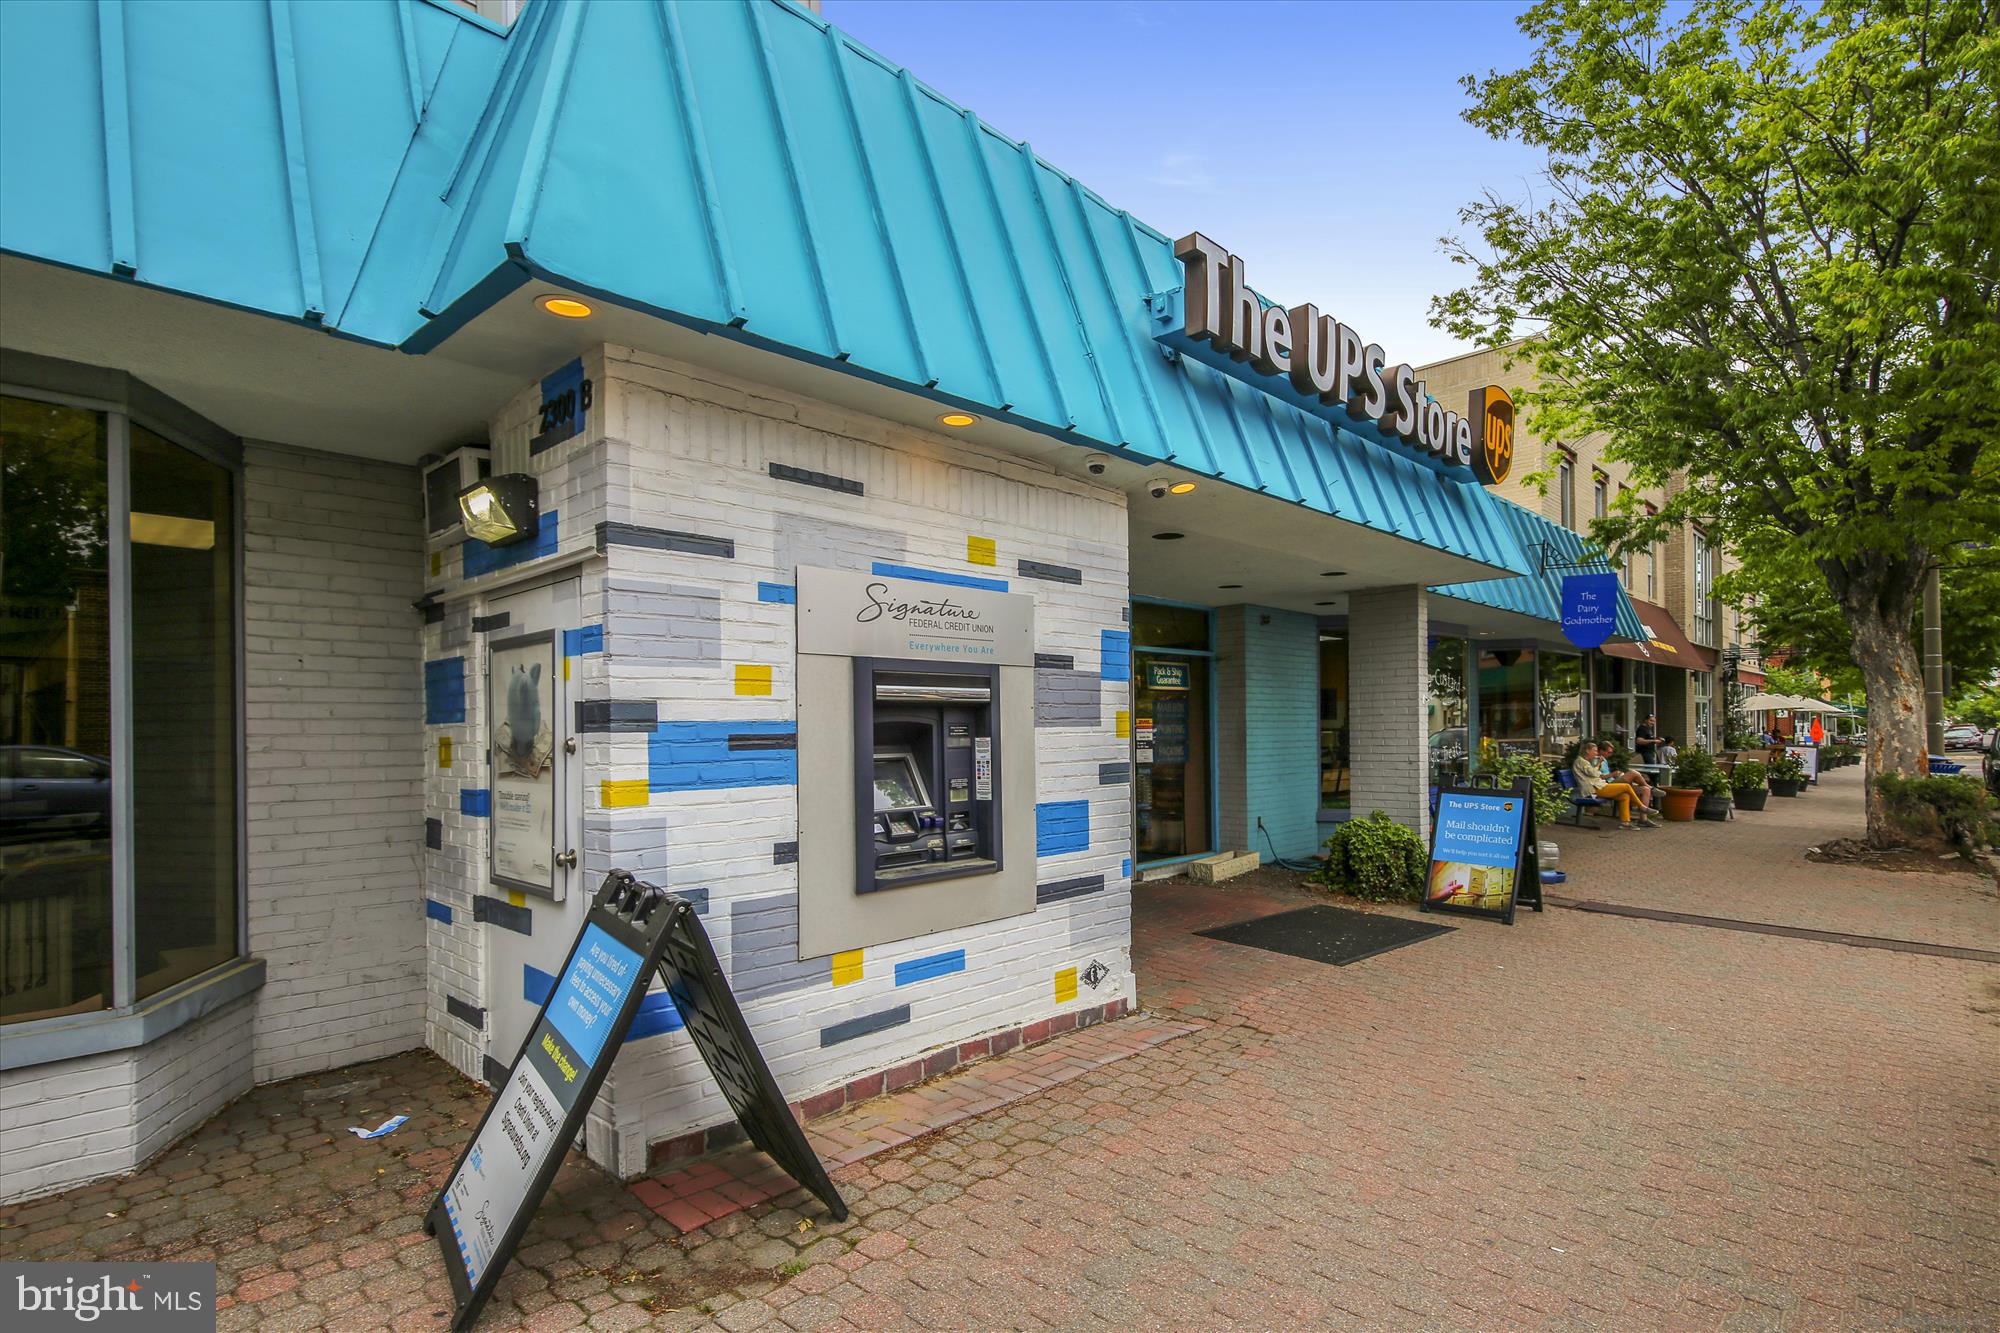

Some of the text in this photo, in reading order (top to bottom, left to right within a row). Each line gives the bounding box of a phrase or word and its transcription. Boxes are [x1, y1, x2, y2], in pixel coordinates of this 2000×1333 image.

[1190, 231, 1472, 466] The UPS Store
[539, 379, 593, 434] 2300 B
[1487, 412, 1512, 468] ups
[856, 583, 981, 622] Signature
[1577, 604, 1600, 613] Dairy
[1580, 592, 1597, 600] The
[909, 618, 994, 633] FEDERAL CREDIT UNION
[1564, 614, 1613, 625] Godmother
[909, 641, 994, 655] Everywhere You Are
[1153, 666, 1166, 675] Pack
[1171, 667, 1182, 677] Ship
[1156, 675, 1181, 685] Guarantee
[1449, 800, 1462, 808] The
[1463, 801, 1479, 810] UPS
[1480, 802, 1501, 811] Store
[1444, 831, 1513, 845] be complicated
[1446, 820, 1510, 833] Mail shouldn't
[1455, 848, 1467, 856] help
[590, 943, 628, 977] Are you tired of
[576, 957, 622, 1002] paying unnecessary
[570, 971, 612, 1017] fees to access your
[576, 1004, 597, 1029] money?
[541, 1033, 578, 1082] Make the change!
[518, 1071, 559, 1132] Join your neighborhood
[514, 1097, 540, 1142] Credit Union at
[502, 1111, 530, 1170] Signaturefcu.org
